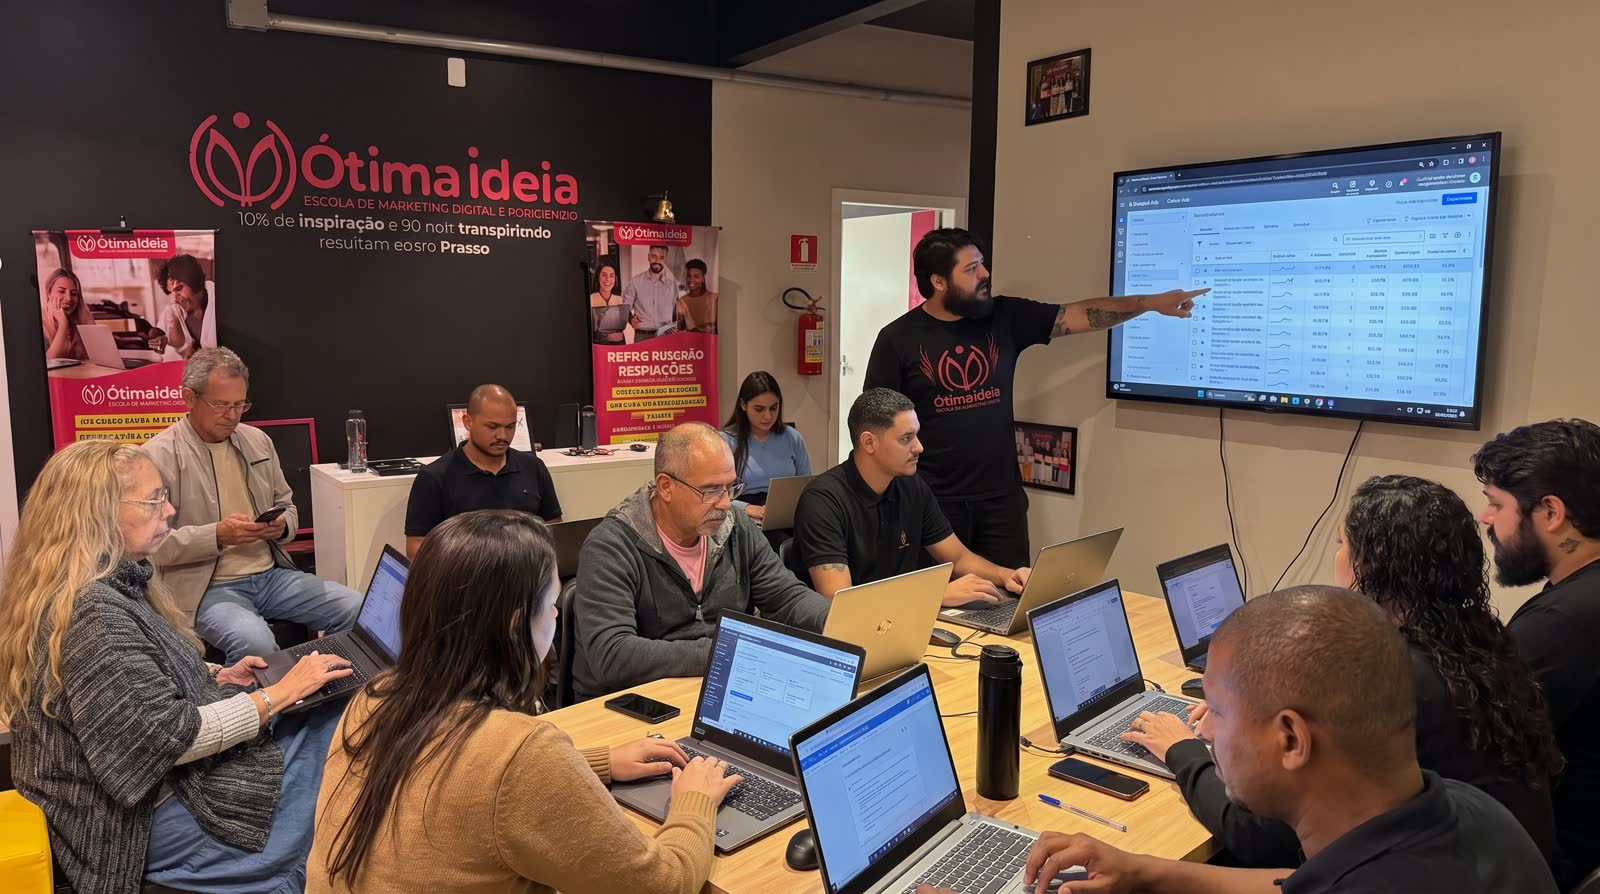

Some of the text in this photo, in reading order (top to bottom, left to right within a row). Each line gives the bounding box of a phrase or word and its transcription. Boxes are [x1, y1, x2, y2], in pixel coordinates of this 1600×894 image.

[304, 195, 355, 209] ESCOLA
[357, 199, 375, 209] DE
[378, 199, 449, 214] MARKETING
[452, 204, 496, 216] DIGITAL
[498, 207, 506, 217] E
[237, 211, 270, 227] 10%
[274, 212, 295, 228] de
[299, 213, 385, 234] inspiração
[388, 220, 398, 231] e
[401, 218, 421, 232] 90
[440, 240, 490, 255] Prasso
[607, 351, 649, 363] REFRG
[107, 384, 183, 400] Ótimaidei
